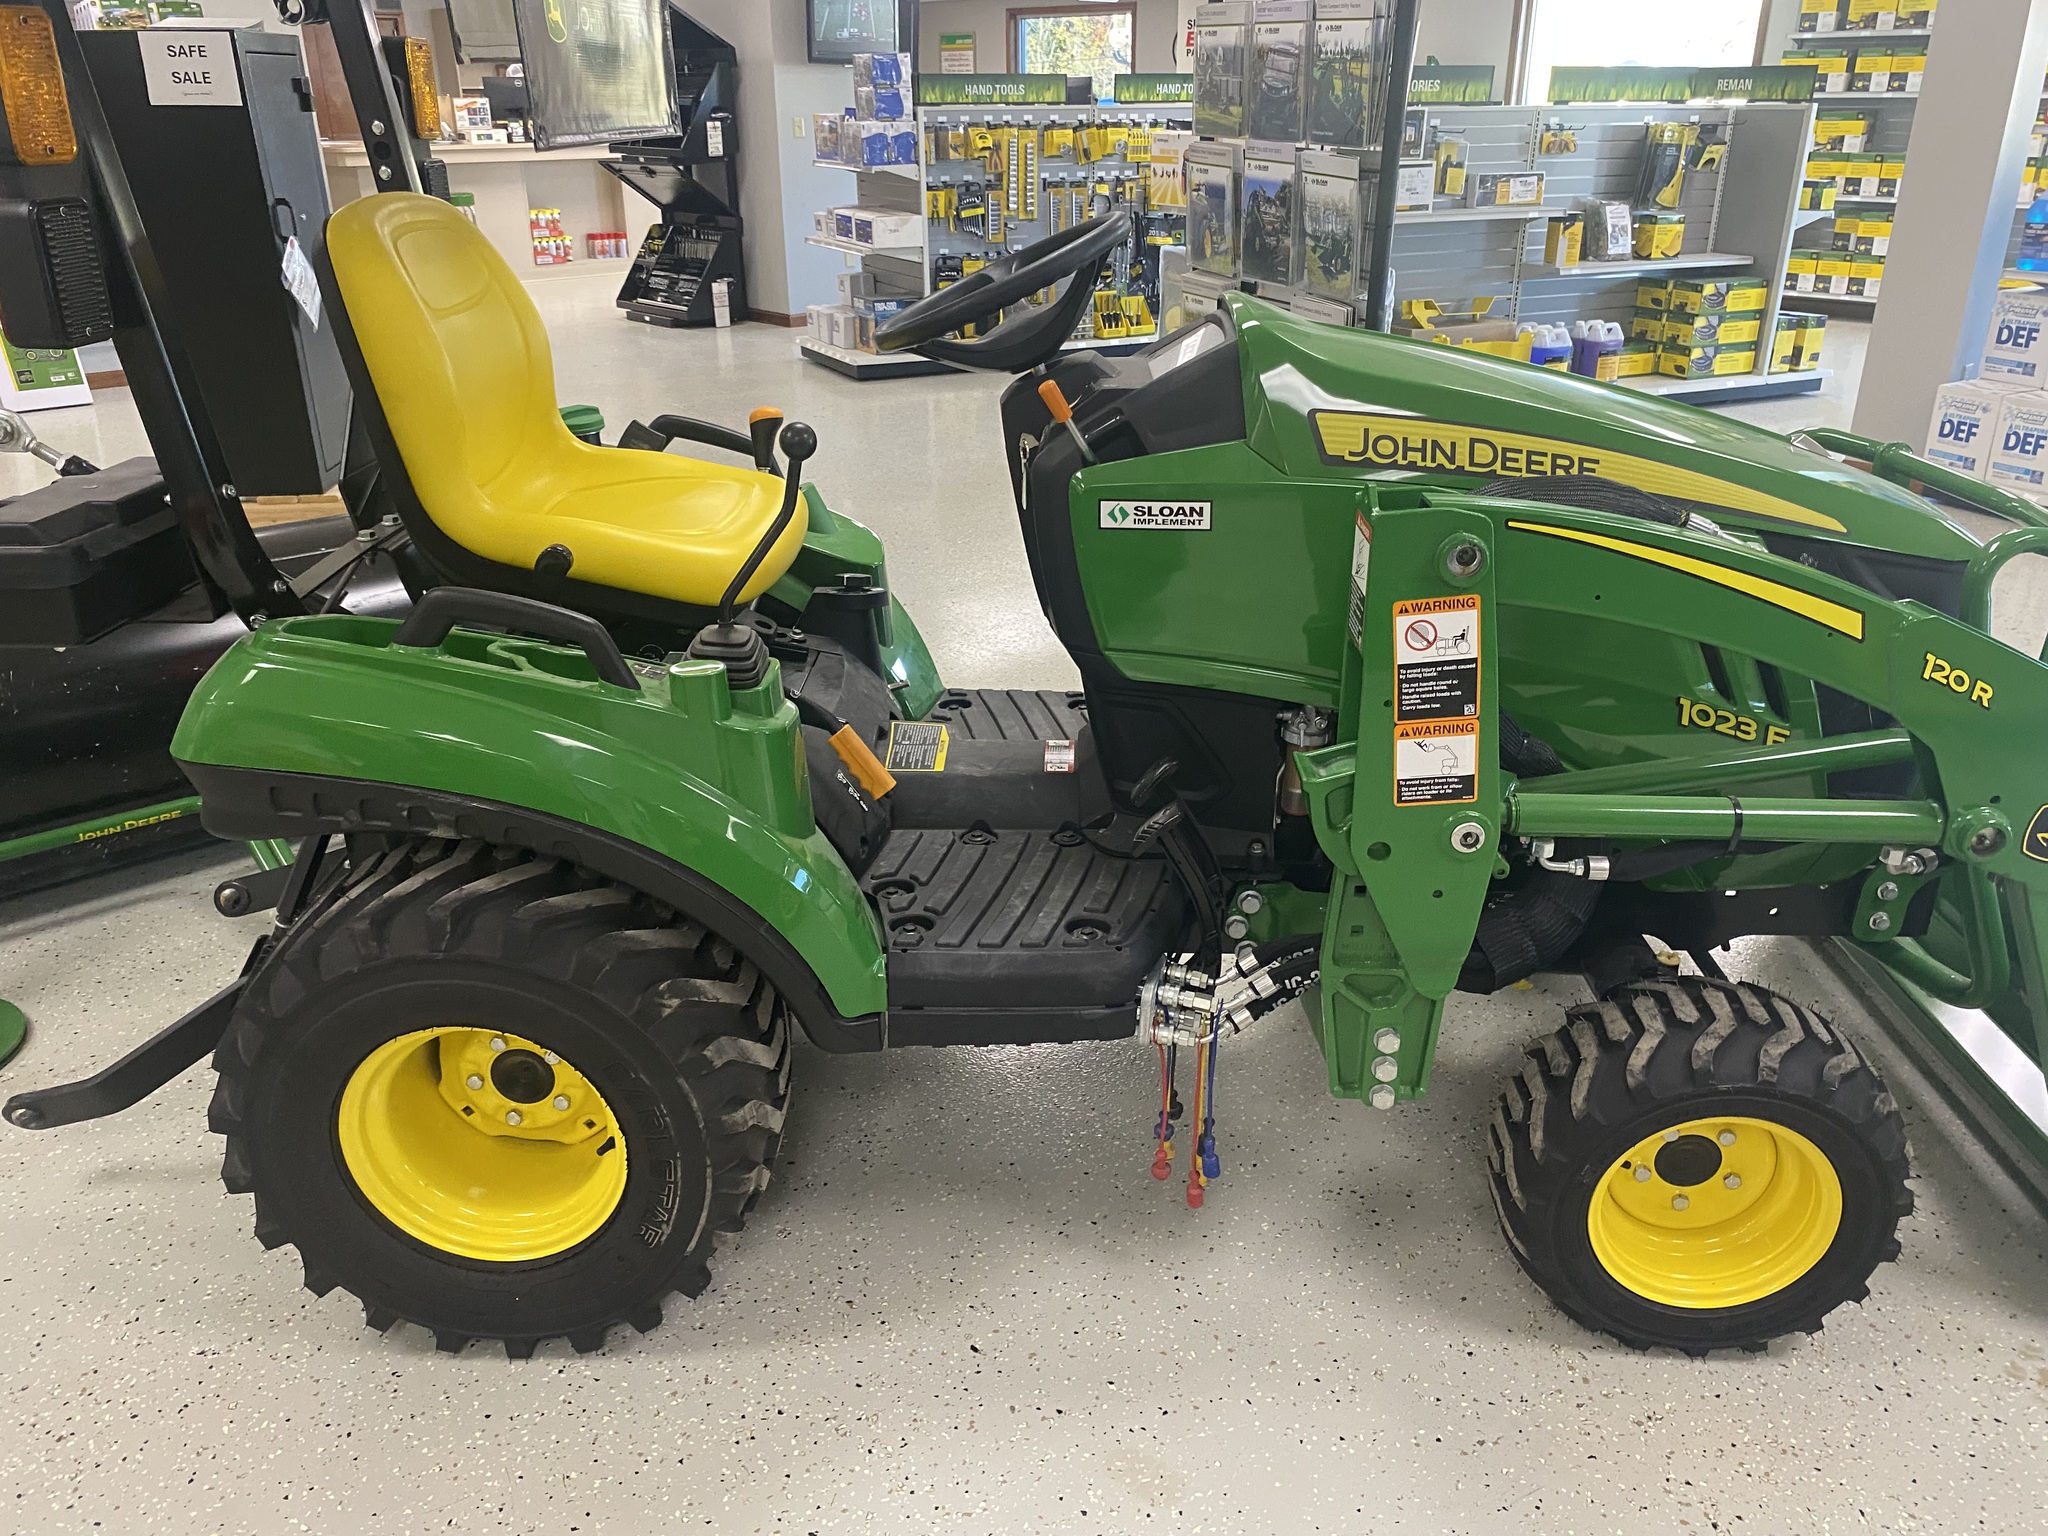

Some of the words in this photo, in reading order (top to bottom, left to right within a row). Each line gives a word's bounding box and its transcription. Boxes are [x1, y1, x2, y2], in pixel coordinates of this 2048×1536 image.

[1187, 19, 1196, 30] S
[166, 45, 208, 58] SAFE
[171, 71, 212, 84] SALE
[965, 84, 993, 96] HAND
[994, 84, 1025, 96] TOOLS
[1156, 83, 1181, 95] HAND
[1182, 83, 1194, 95] TO
[1411, 79, 1441, 92] ORIES
[1717, 78, 1753, 91] REMAN
[1995, 325, 2040, 348] DEF
[1950, 401, 1979, 411] PRIME
[2016, 413, 2046, 423] PRIME
[1938, 419, 1979, 443] DEF
[2003, 431, 2047, 456] DEF
[1347, 427, 1456, 465] JOHN
[1468, 437, 1600, 476] DEERE
[1133, 505, 1204, 518] SLOAN
[1133, 518, 1204, 526] IMPLEMENT
[1411, 597, 1476, 613] WARNING
[1923, 652, 1970, 693] 120
[1971, 680, 1993, 708] R
[1679, 697, 1758, 741] 1023
[1411, 722, 1475, 737] WARNING
[75, 825, 121, 843] JOHN
[124, 810, 181, 830] DEERE
